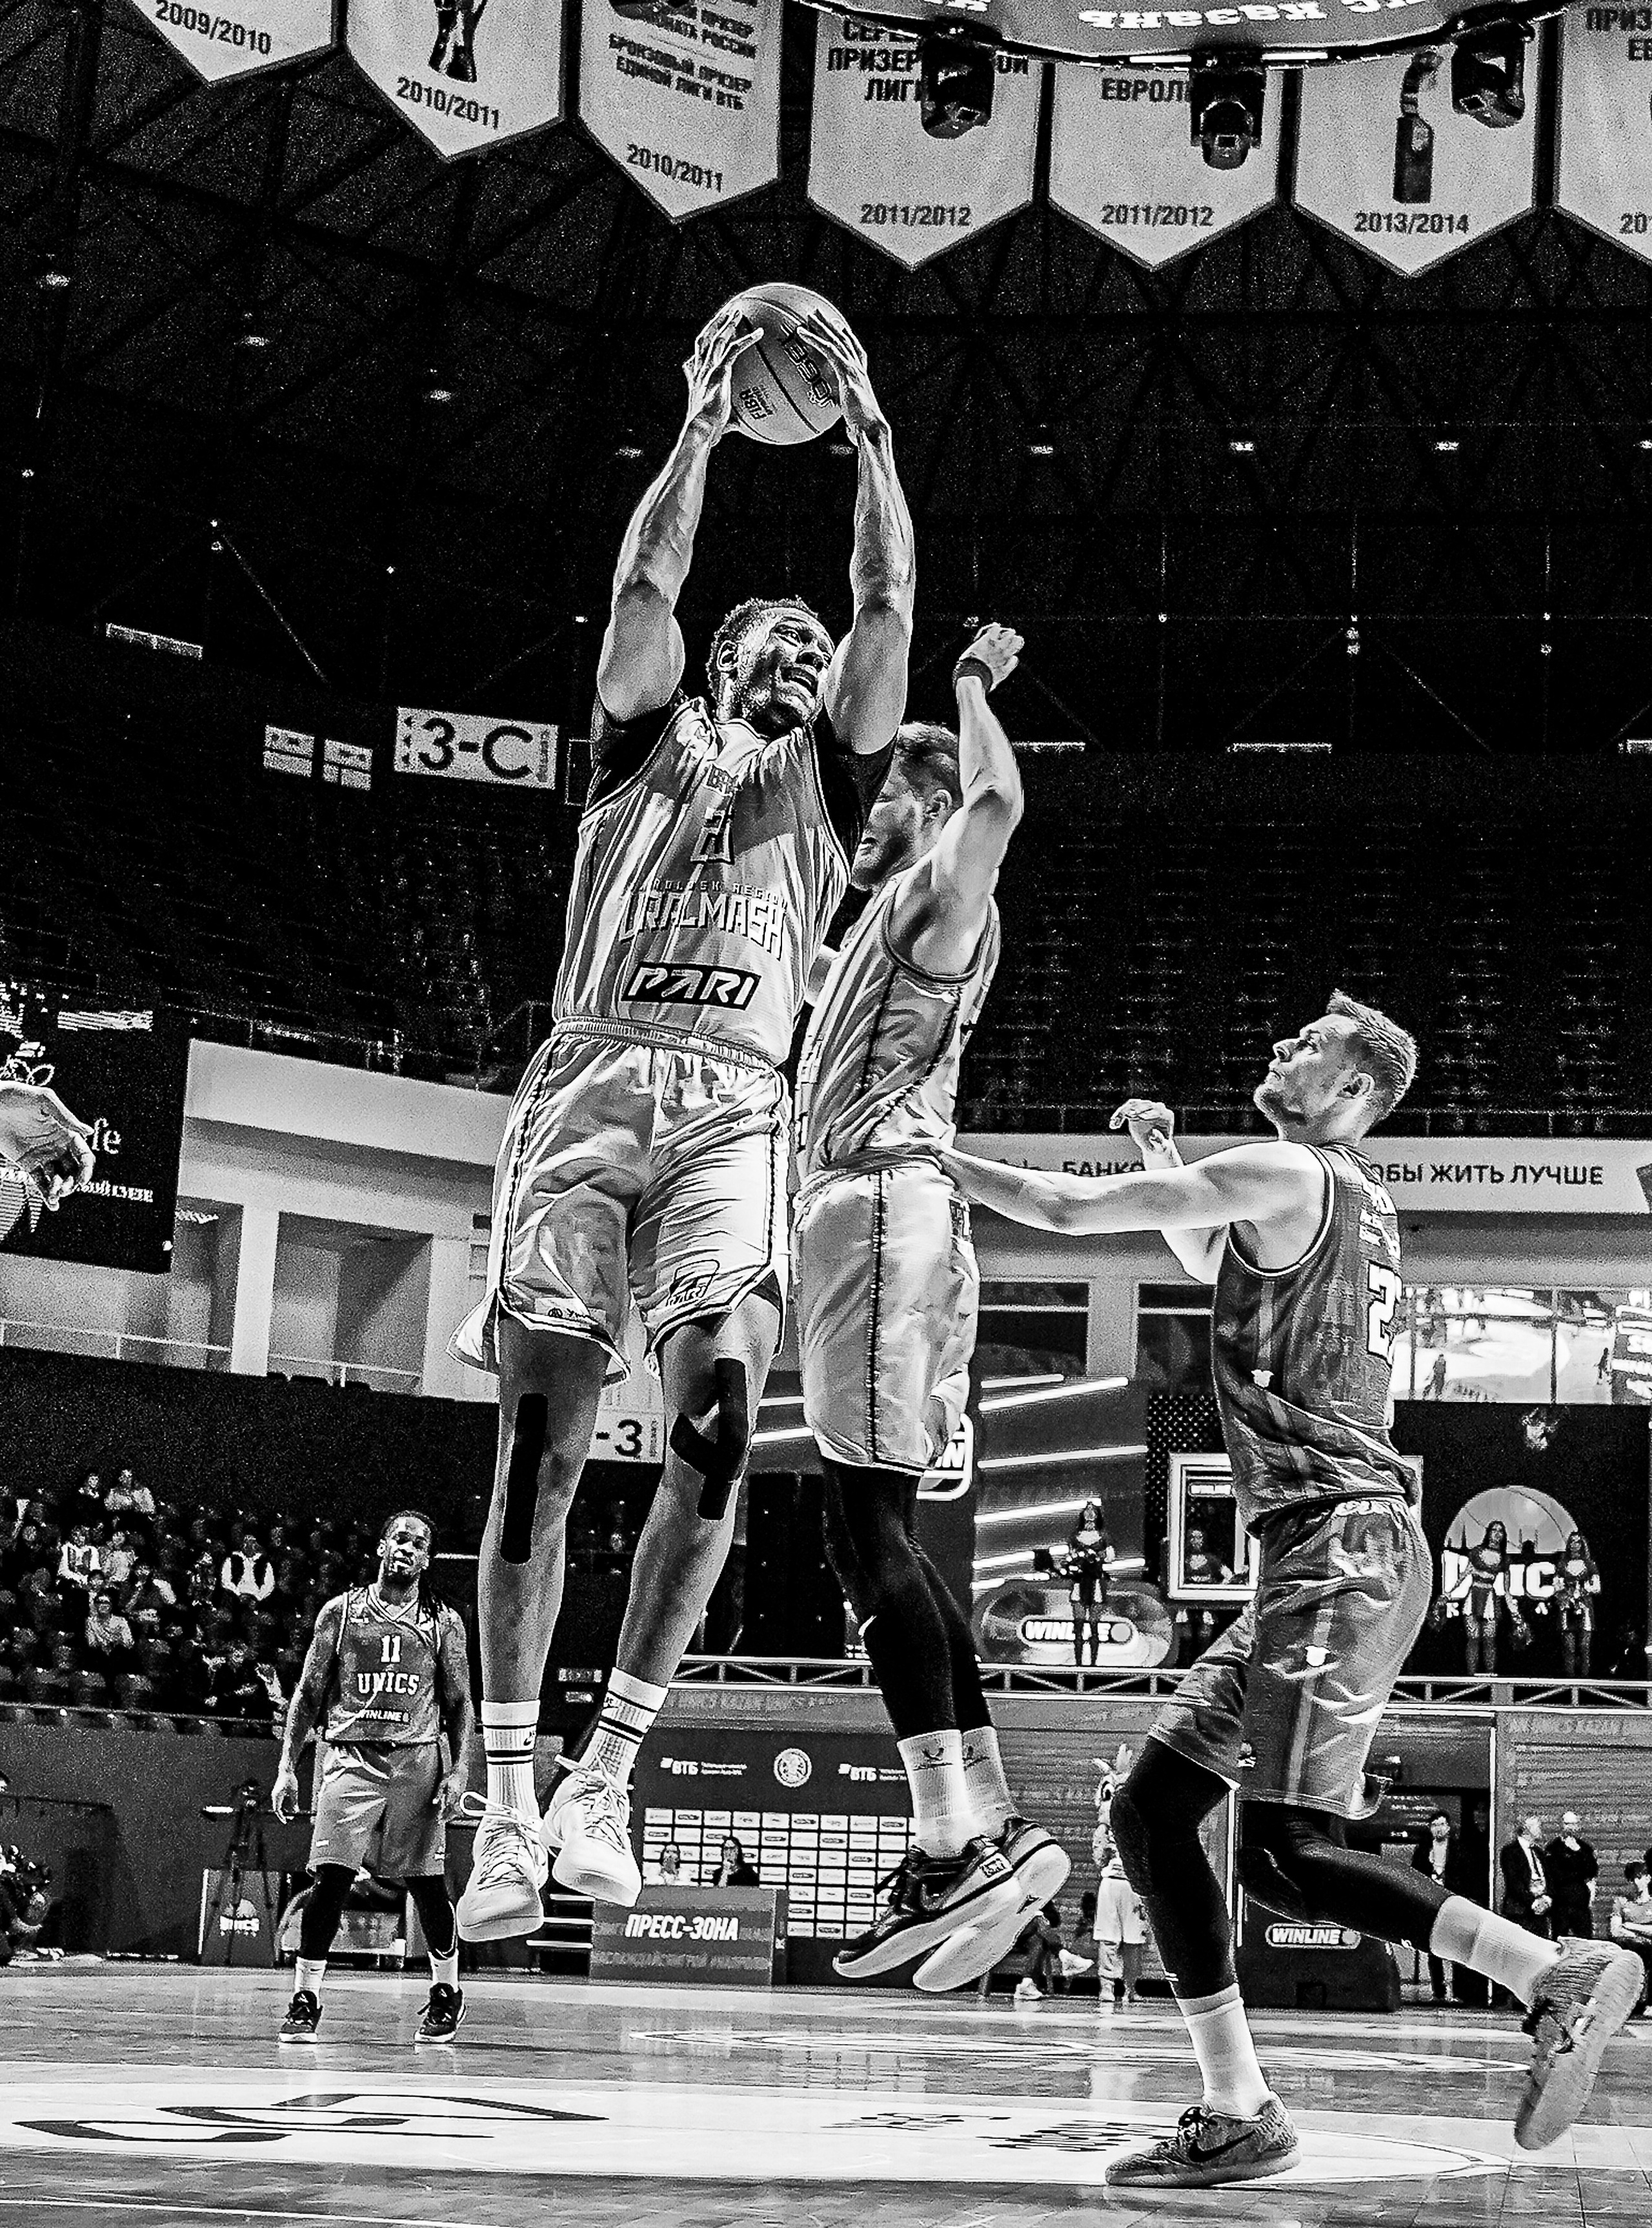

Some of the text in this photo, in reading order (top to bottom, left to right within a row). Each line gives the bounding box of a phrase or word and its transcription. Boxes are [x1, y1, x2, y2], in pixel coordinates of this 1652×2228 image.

[156, 0, 271, 55] 2009/2010
[396, 76, 500, 130] 2010/2011
[1101, 77, 1193, 102] ЕВРОЛ
[626, 143, 723, 193] 2010/2011
[860, 203, 971, 227] 2011/2012
[1100, 204, 1214, 228] 2011/2012
[1354, 210, 1469, 234] 2013/2014
[619, 891, 786, 960] URALMASH
[628, 967, 754, 1005] PARI
[1430, 1164, 1504, 1184] ЖИТЬ
[1510, 1164, 1604, 1185] ЛУЧШЕ
[381, 1634, 401, 1663] 11
[357, 1672, 419, 1696] UNICS
[624, 1907, 739, 1941] ПРЕСС-ЗОНА
[1272, 1927, 1341, 1945] WINLINE
